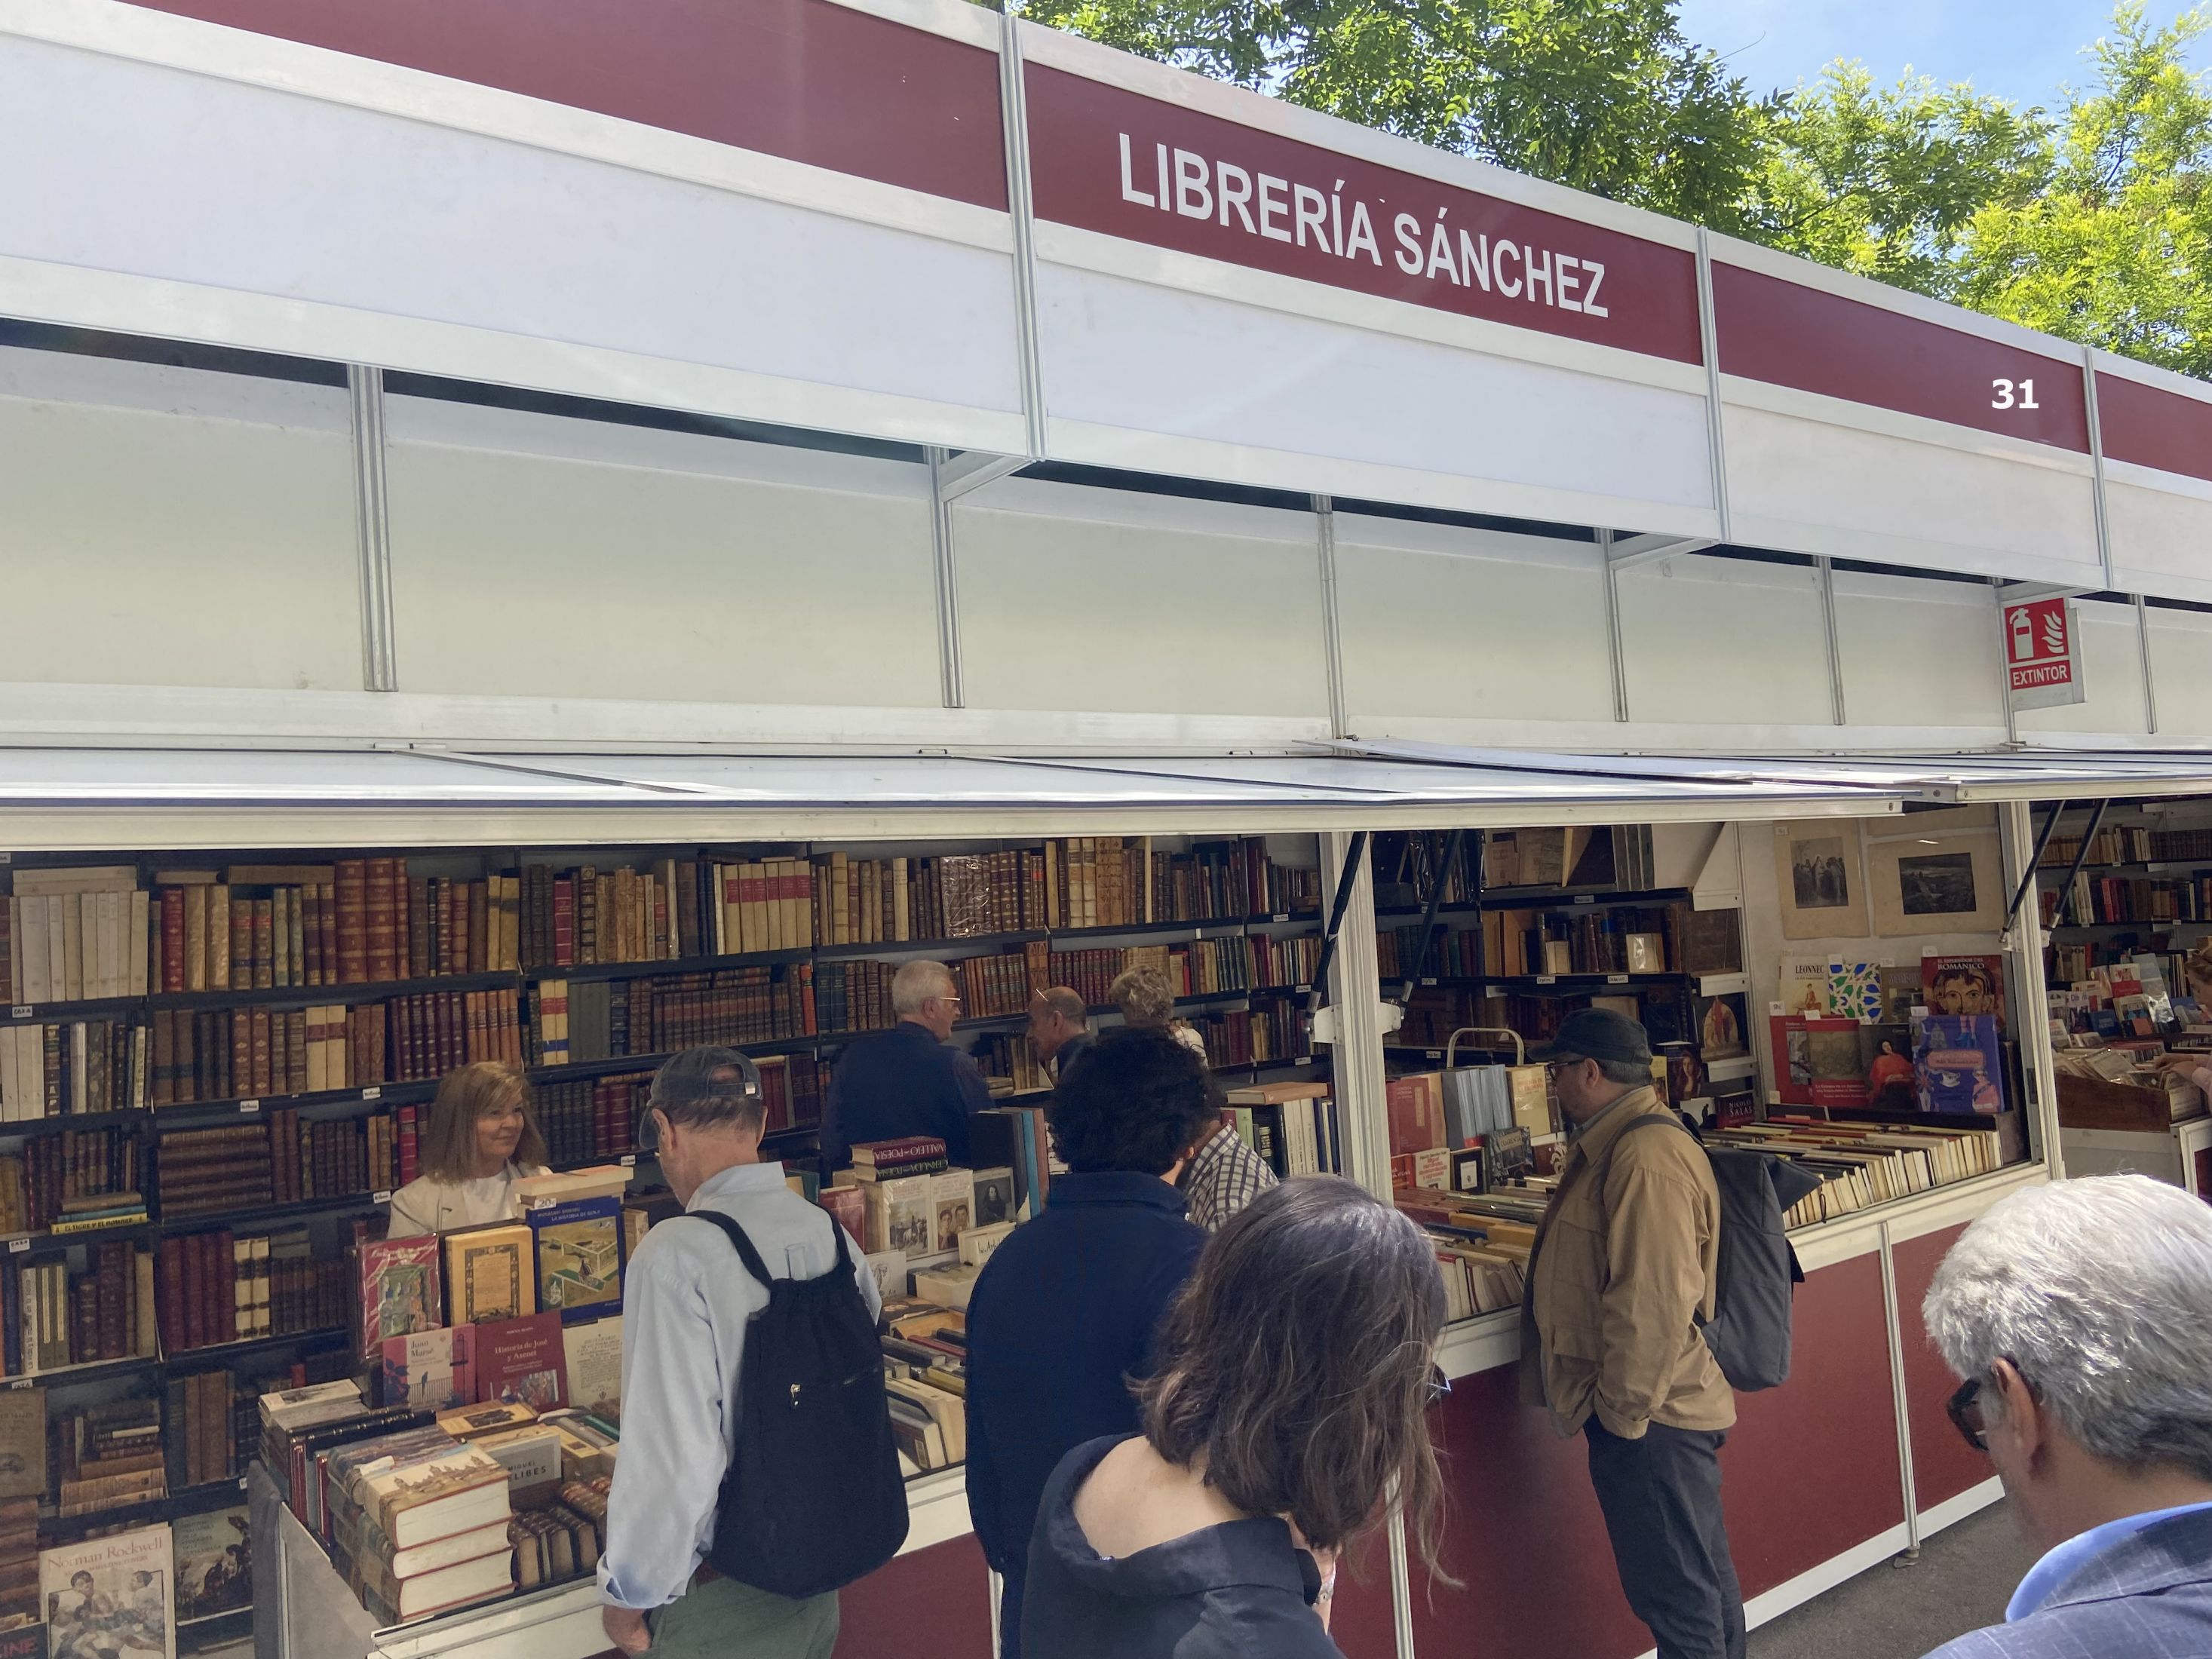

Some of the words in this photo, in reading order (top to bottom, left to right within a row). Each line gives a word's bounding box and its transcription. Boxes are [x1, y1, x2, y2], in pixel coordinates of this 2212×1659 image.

[1119, 133, 1382, 266] LIBRERÍA
[1394, 207, 1609, 318] SÁNCHEZ
[1992, 379, 2039, 409] 31
[2013, 665, 2068, 686] EXTINTOR
[1795, 964, 1824, 974] LEONNEC
[1937, 962, 1985, 971] ROMÁNICO
[72, 1223, 90, 1231] TIGRE
[411, 1340, 429, 1350] Juan
[495, 1343, 523, 1354] Historia
[524, 1342, 532, 1350] de
[533, 1339, 548, 1349] José
[508, 1460, 535, 1471] MIGUEL
[48, 1552, 103, 1569] Norman
[107, 1536, 162, 1559] Rockwell
